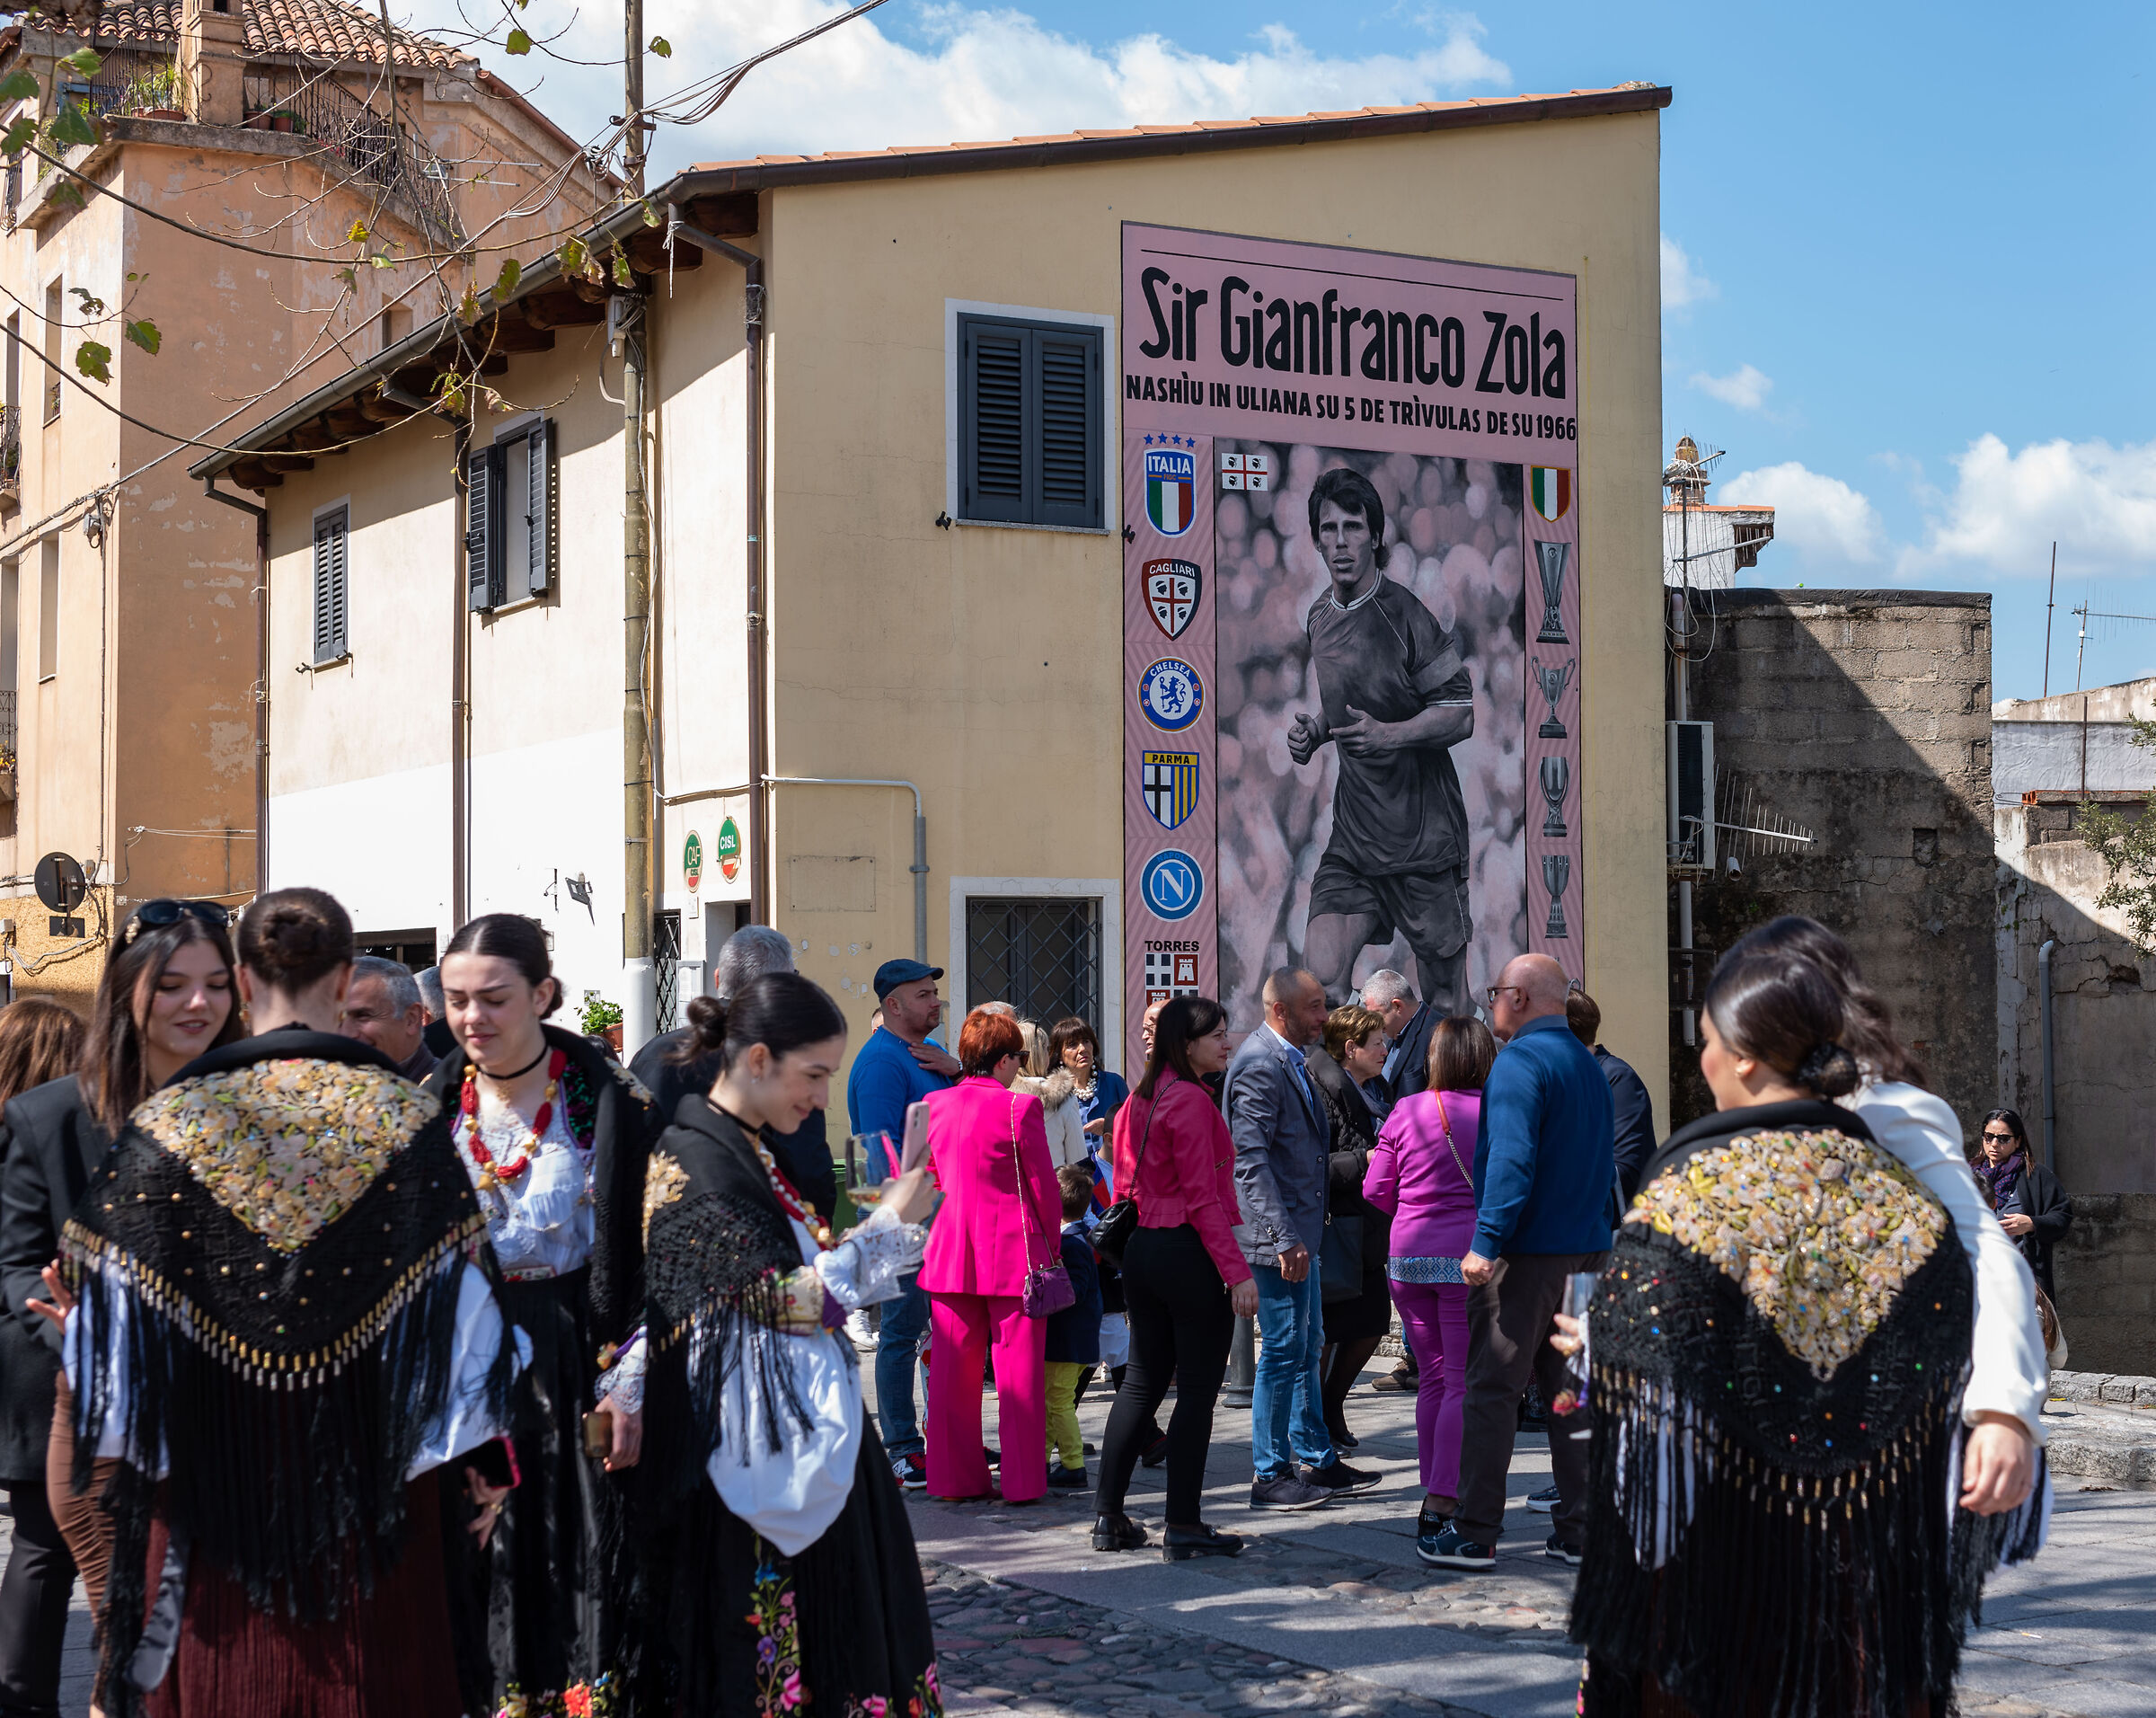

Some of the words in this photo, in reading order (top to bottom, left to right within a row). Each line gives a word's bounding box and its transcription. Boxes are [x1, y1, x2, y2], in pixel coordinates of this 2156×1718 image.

[1139, 267, 1208, 362] Sir
[1221, 277, 1465, 388] Gianfranco
[1475, 311, 1566, 400] Zola
[1127, 371, 1204, 405] NASHÌU
[1210, 383, 1231, 408] IN
[1236, 385, 1312, 417] ULIANA
[1316, 394, 1339, 420] SU
[1345, 397, 1356, 421] 5
[1361, 398, 1384, 423] DE
[1390, 395, 1481, 433] TRÌVULAS
[1487, 411, 1508, 436] DE
[1512, 413, 1533, 438] SU
[1535, 415, 1577, 441] 1966
[1148, 456, 1191, 474] ITALIA
[1149, 562, 1196, 578] CAGLIARI
[1150, 661, 1191, 677] CHELSEA
[1152, 754, 1190, 765] PARMA
[720, 835, 736, 850] CISL
[688, 846, 701, 866] CAF
[1156, 852, 1189, 863] NAPOLI
[1159, 869, 1187, 901] N
[1144, 940, 1200, 952] TORRES
